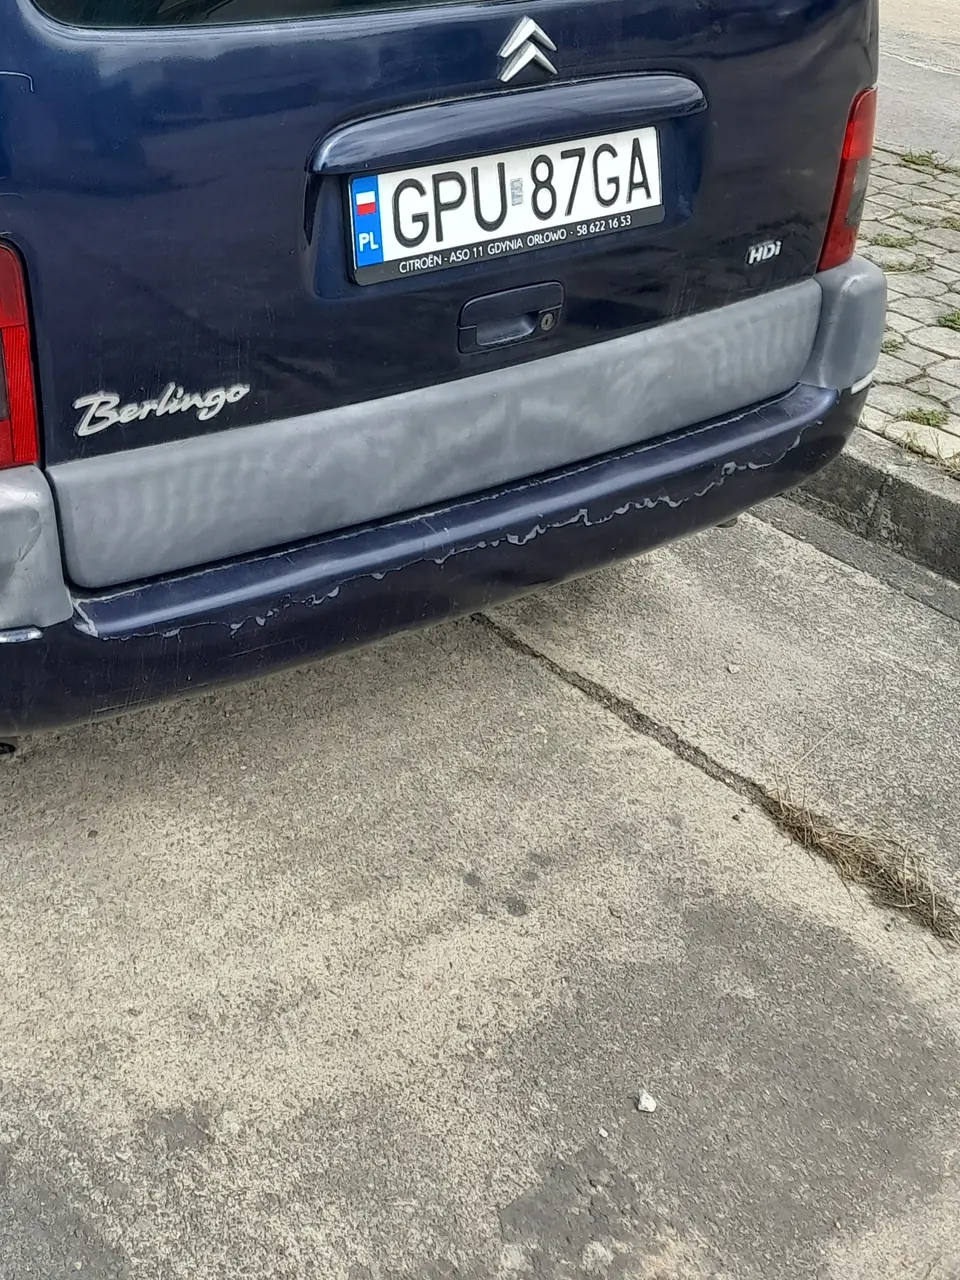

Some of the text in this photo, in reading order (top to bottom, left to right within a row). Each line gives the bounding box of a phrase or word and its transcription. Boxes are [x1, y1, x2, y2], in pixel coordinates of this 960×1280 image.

[392, 137, 652, 247] GPU 87GA
[358, 231, 379, 253] PL
[399, 254, 442, 273] CITROËN
[449, 249, 470, 263] ASO
[472, 246, 484, 258] 11
[487, 240, 524, 255] GDYNIA
[527, 229, 567, 247] ORŁOWO
[576, 224, 588, 236] 58
[589, 220, 606, 233] 622
[608, 218, 619, 229] 16
[620, 215, 632, 226] 53
[748, 240, 782, 264] HDi
[73, 382, 250, 437] Berlingo
